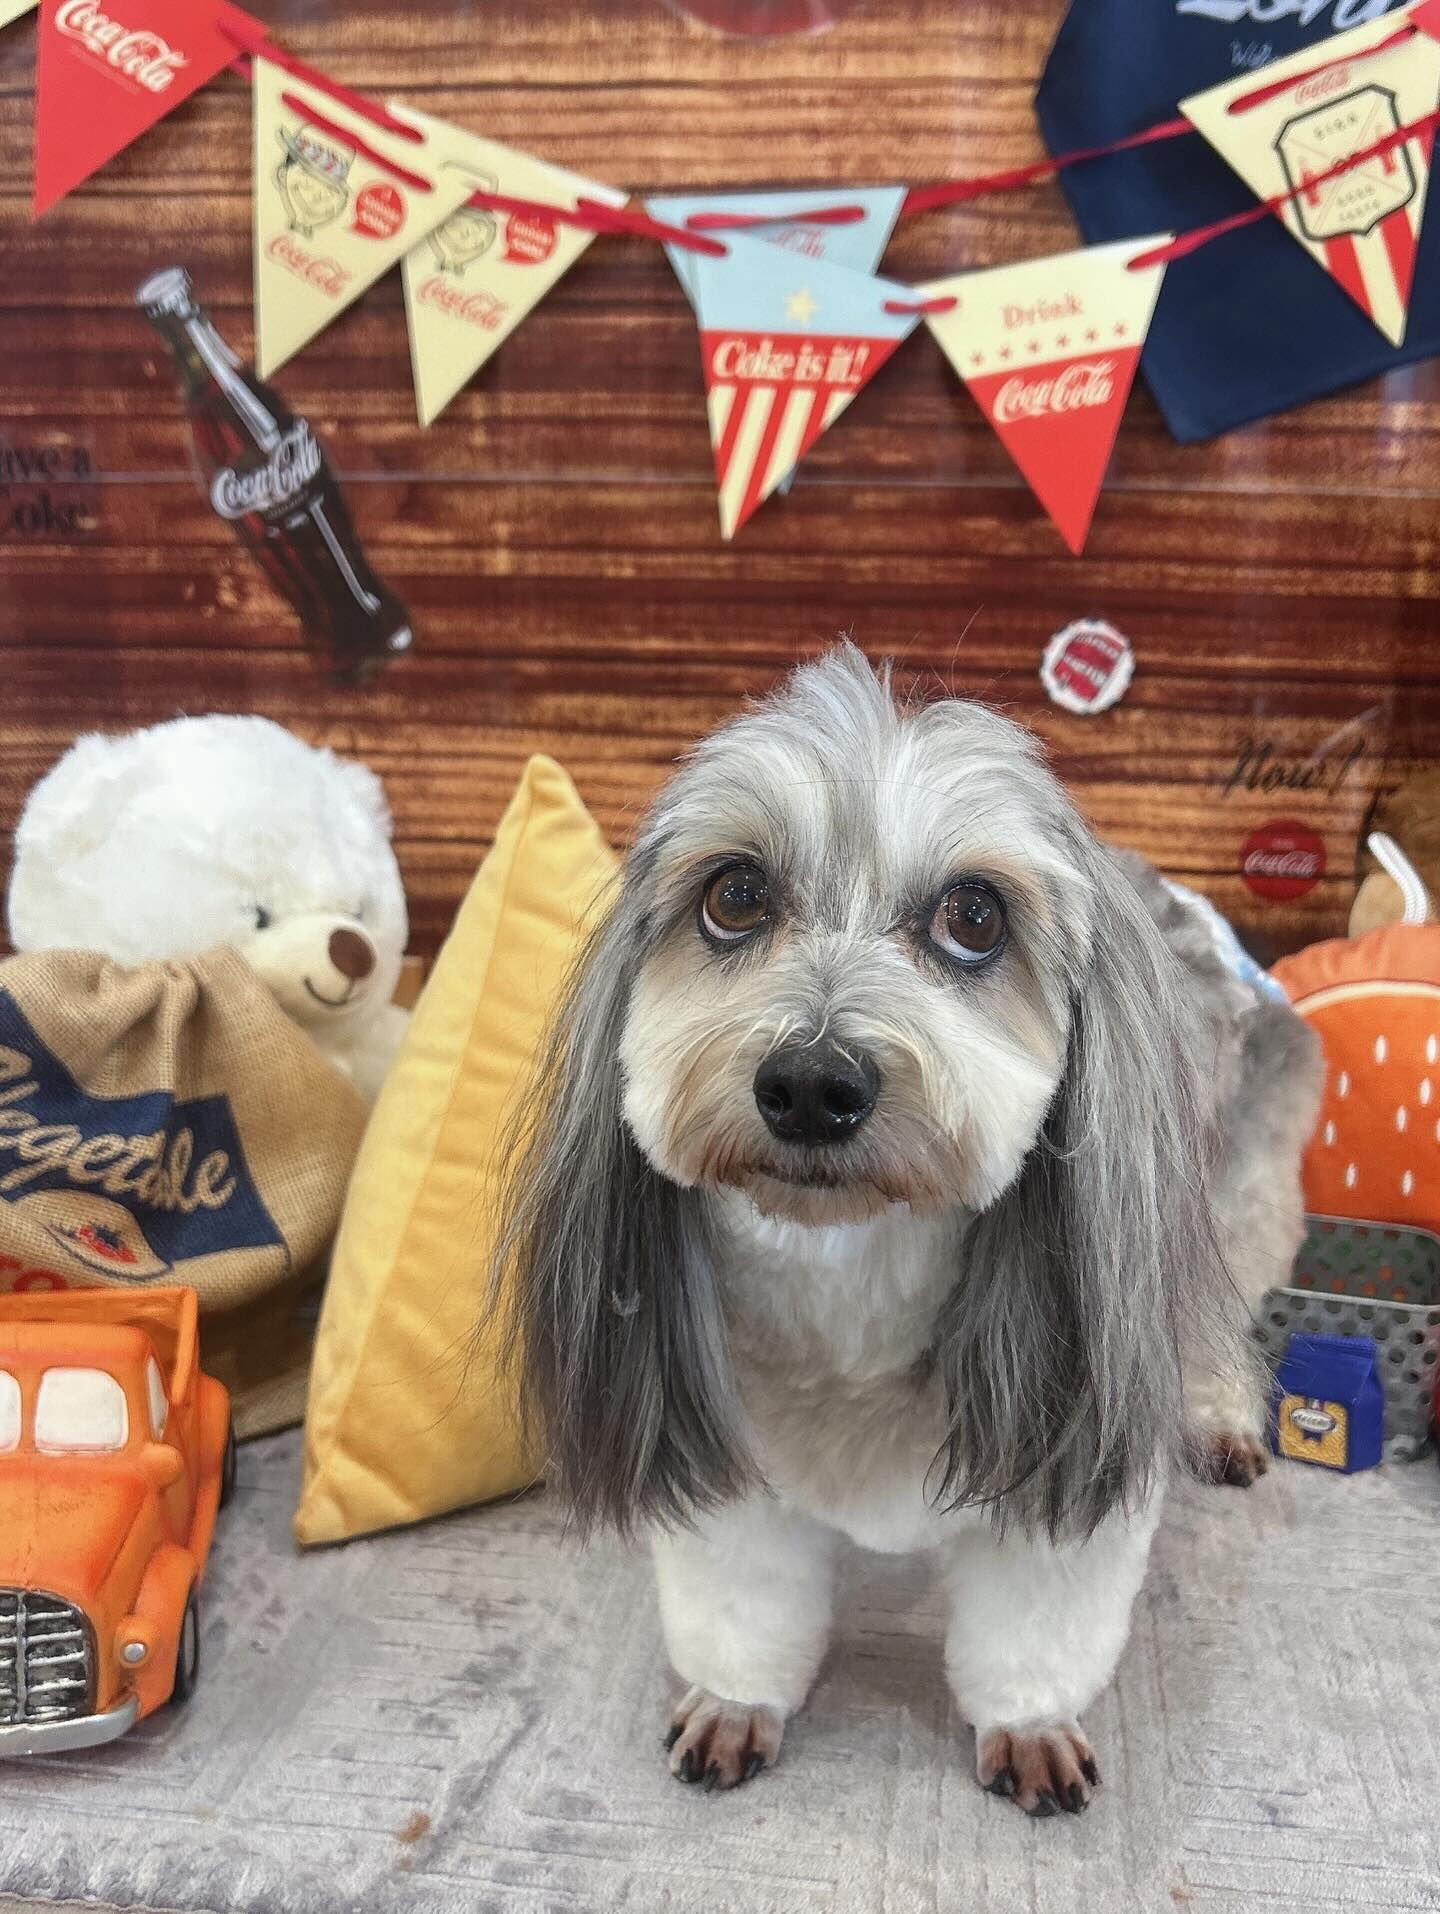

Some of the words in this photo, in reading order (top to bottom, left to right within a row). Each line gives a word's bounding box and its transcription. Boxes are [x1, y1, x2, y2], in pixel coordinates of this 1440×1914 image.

[1003, 290, 1083, 330] Drink
[713, 337, 795, 382] Coke
[793, 341, 827, 383] is
[823, 343, 870, 386] it!
